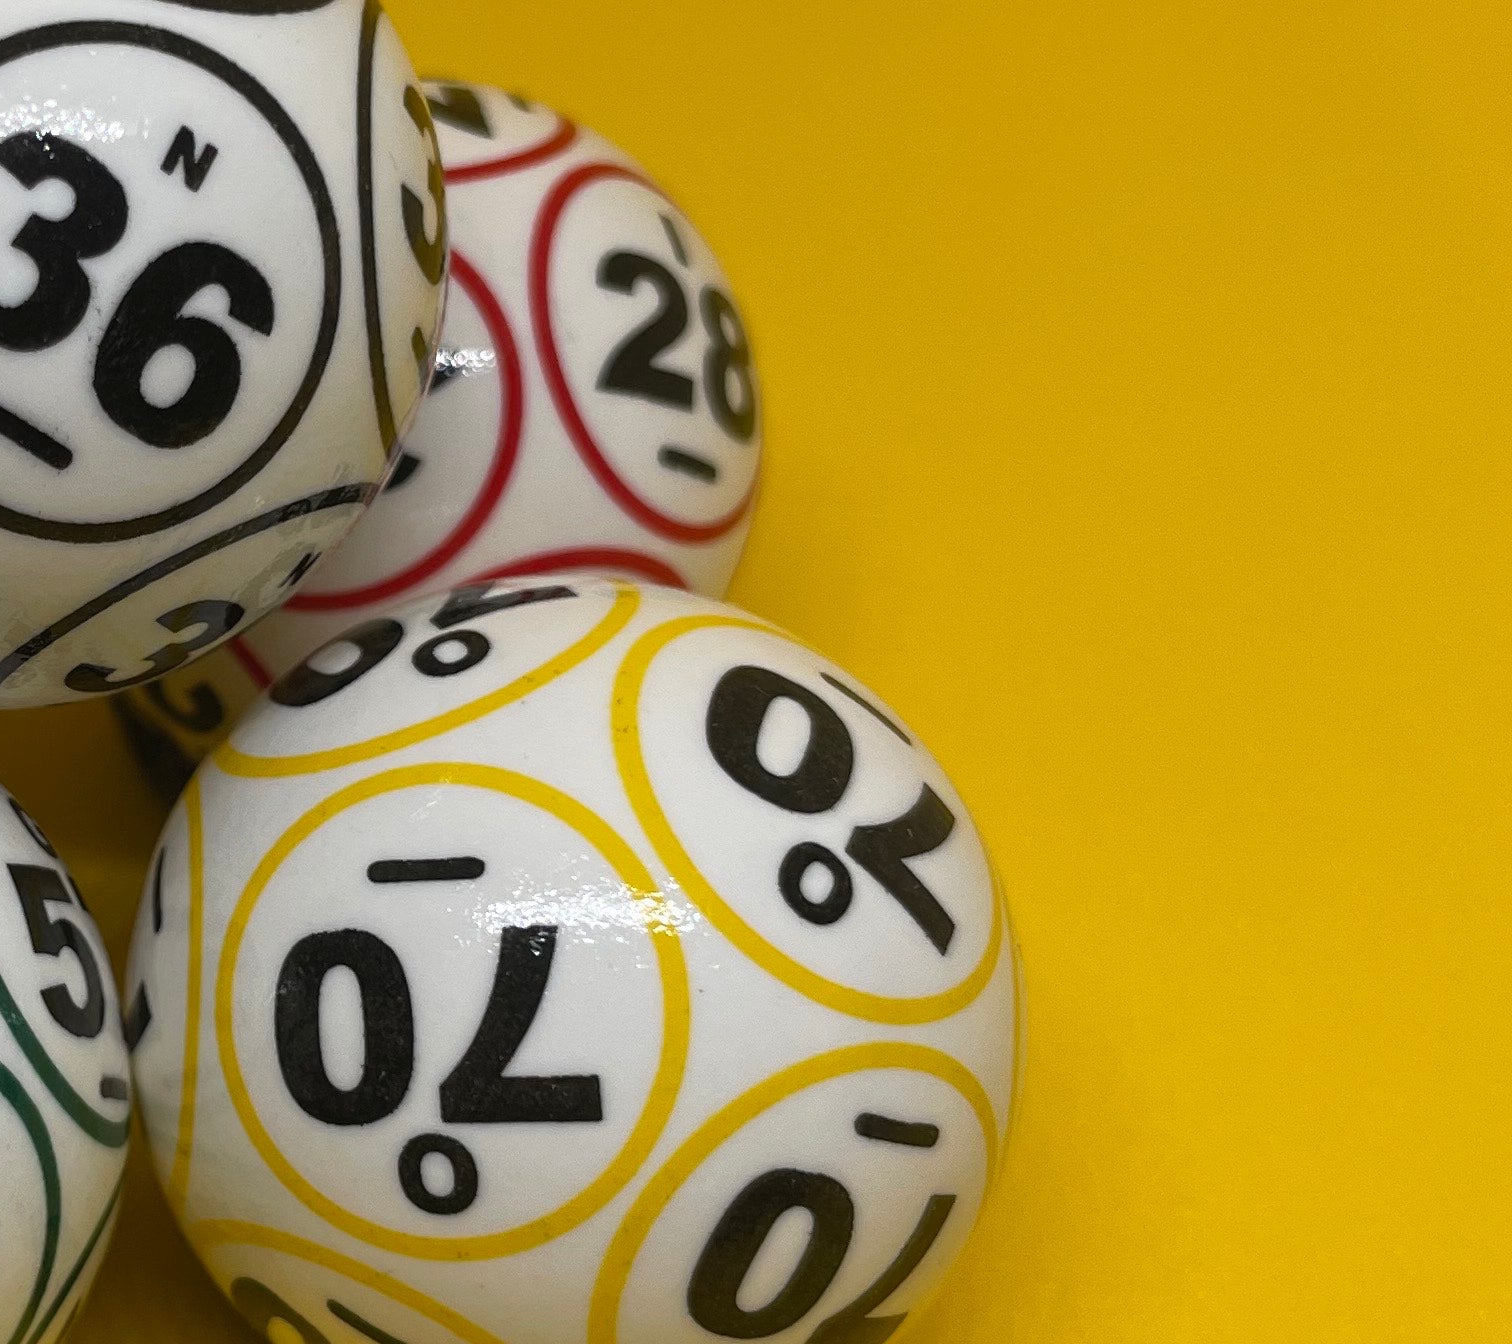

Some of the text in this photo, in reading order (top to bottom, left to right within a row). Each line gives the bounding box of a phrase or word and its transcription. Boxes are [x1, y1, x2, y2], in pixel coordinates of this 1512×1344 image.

[160, 125, 218, 192] N
[595, 251, 758, 442] 28
[706, 664, 956, 957] 70
[6, 862, 105, 1039] 5
[275, 924, 604, 1127] 70
